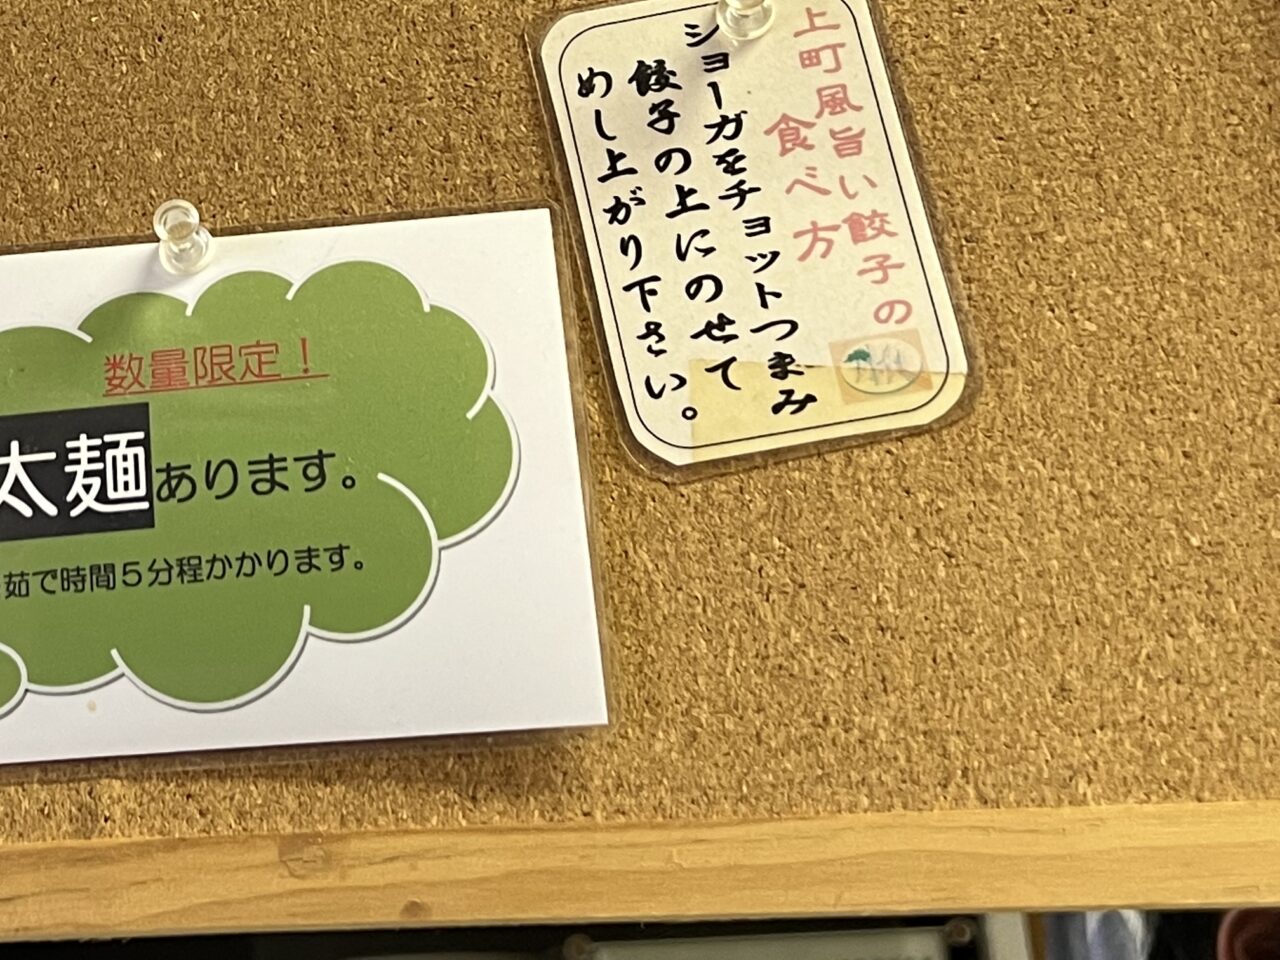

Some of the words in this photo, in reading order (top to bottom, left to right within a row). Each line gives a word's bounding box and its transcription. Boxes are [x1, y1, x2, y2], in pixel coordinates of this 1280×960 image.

[577, 67, 699, 421] めし上がり下さい。
[627, 59, 743, 391] 餃子の上にのせて
[683, 23, 818, 416] ショーガをチョットつまみ
[764, 113, 842, 262] 食べ方
[793, 7, 913, 325] 上町風旨い餃子の
